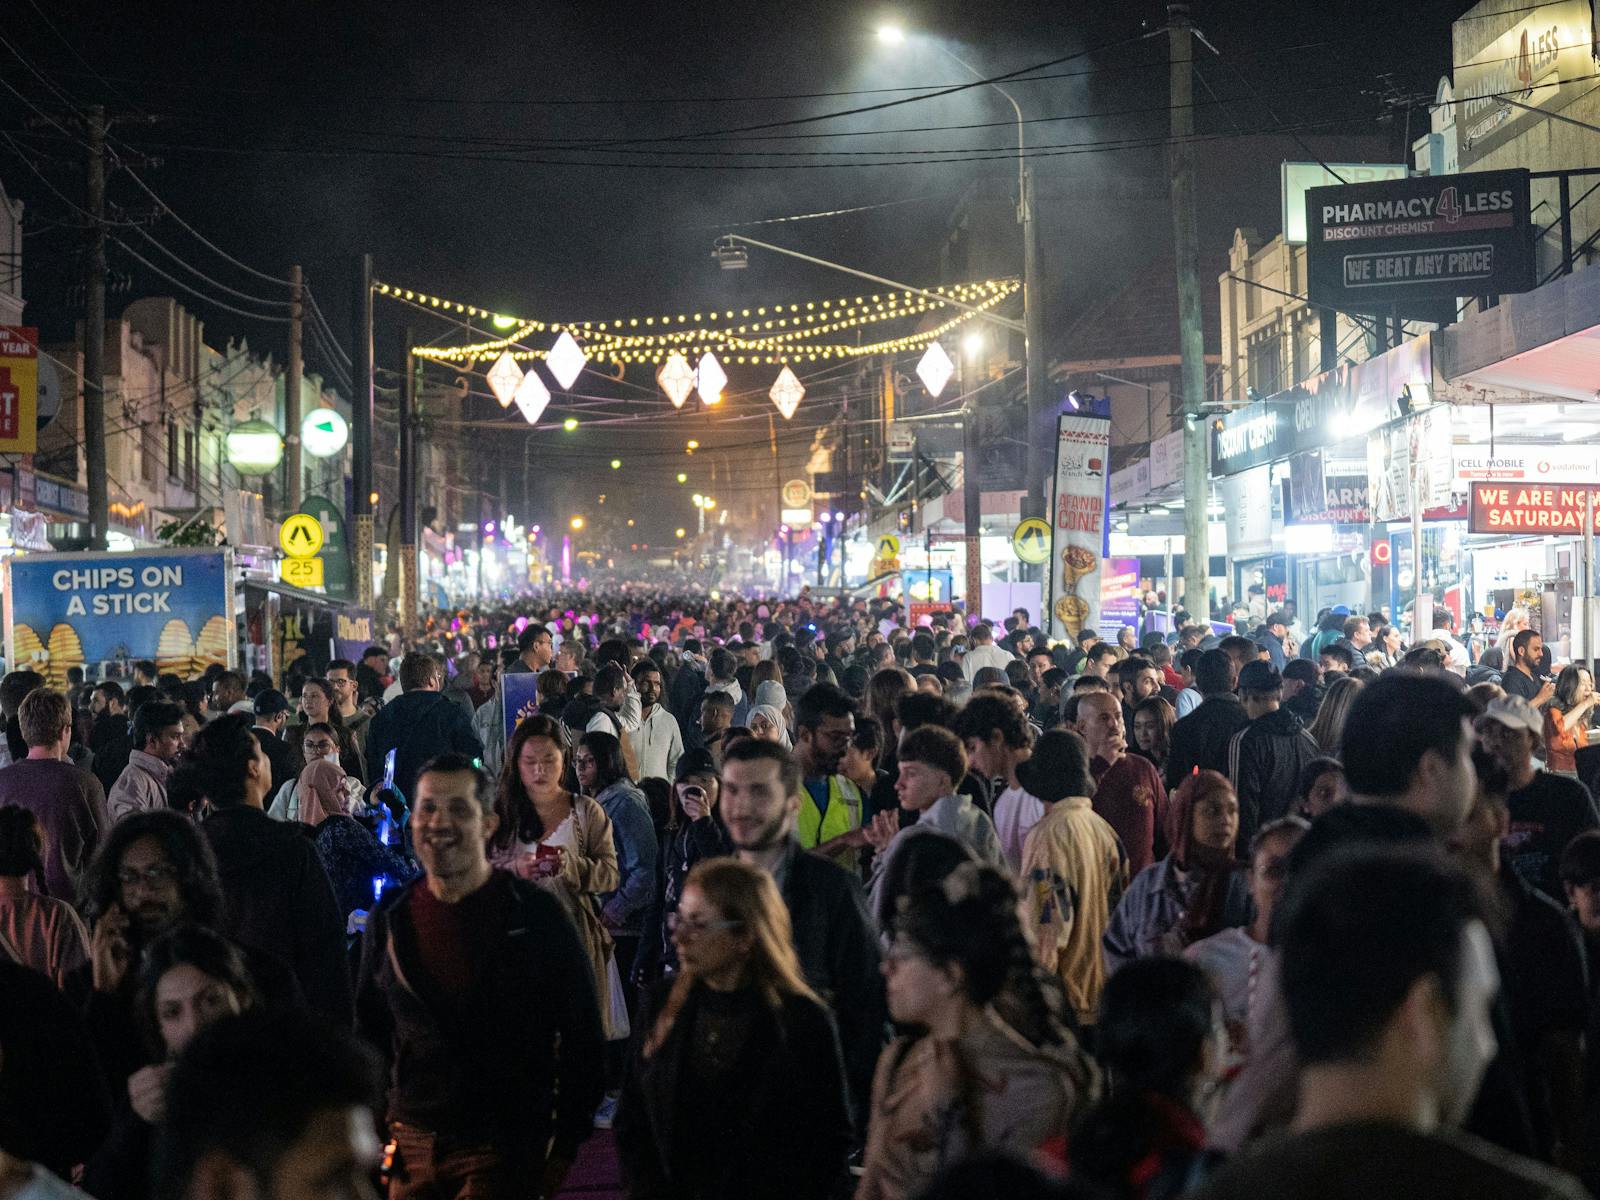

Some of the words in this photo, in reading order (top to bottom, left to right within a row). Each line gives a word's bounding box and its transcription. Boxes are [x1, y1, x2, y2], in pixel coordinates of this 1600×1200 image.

[1532, 25, 1559, 71] LESS
[1322, 196, 1435, 224] PHARMACY
[1436, 186, 1463, 224] 4
[1465, 191, 1514, 213] LESS
[1325, 225, 1383, 240] DISCOUNT
[1385, 221, 1434, 234] CHEMIST
[1347, 259, 1371, 281] WE
[1375, 256, 1412, 278] BEAT
[1414, 254, 1444, 276] ANY
[1448, 250, 1491, 273] PRICE
[2, 342, 30, 354] YEAR
[1458, 459, 1482, 468] iCELL
[1486, 459, 1524, 468] MOBILE
[1058, 493, 1102, 512] AFANDI
[1479, 489, 1509, 506] WE
[1516, 490, 1553, 506] ARE
[1058, 510, 1101, 533] CONE
[1301, 507, 1363, 522] DISCOUNT
[1488, 508, 1585, 527] SATURDAY
[290, 561, 313, 575] 25
[52, 567, 135, 591] CHIPS
[141, 565, 183, 587] ON
[66, 595, 87, 616] A
[92, 592, 172, 616] STICK
